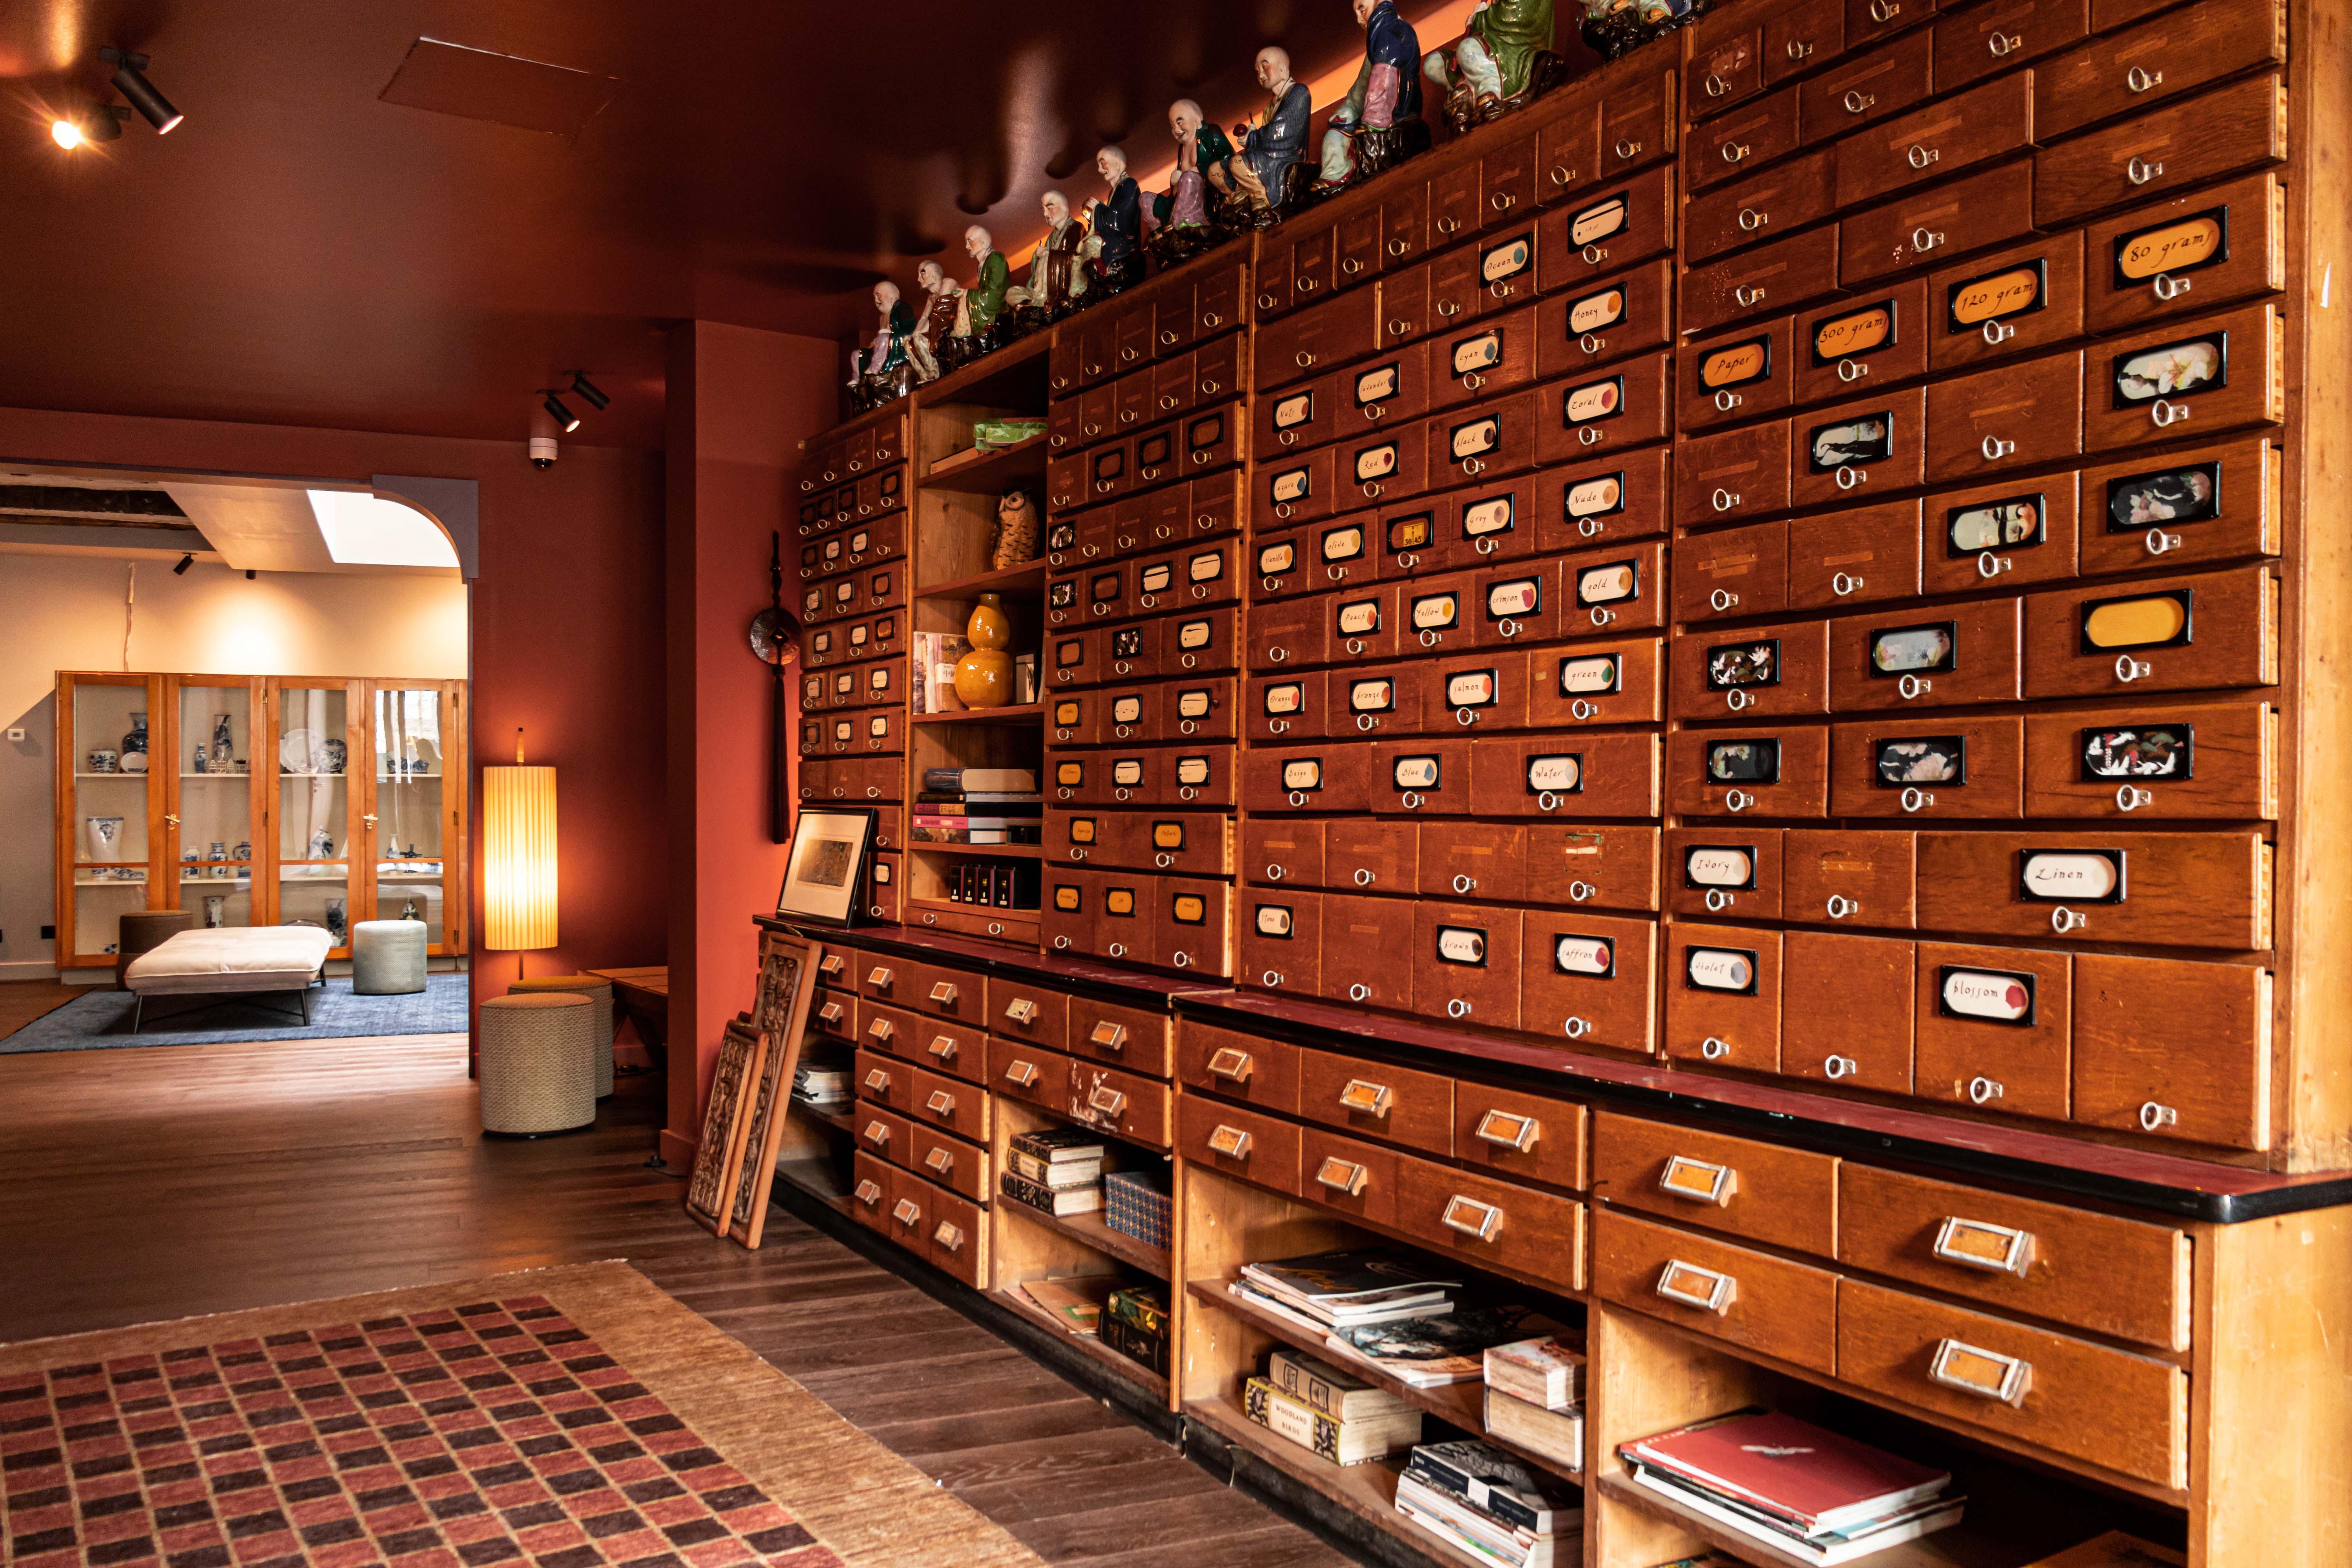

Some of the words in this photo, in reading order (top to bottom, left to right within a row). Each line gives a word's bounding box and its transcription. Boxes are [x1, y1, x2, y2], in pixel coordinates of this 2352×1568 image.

[2131, 245, 2150, 263] 80
[2152, 230, 2215, 268] grams
[1486, 258, 1511, 272] Ocean
[1962, 294, 1987, 311] 120
[1575, 308, 1598, 323] Honey
[1820, 326, 1844, 343] 300
[1460, 351, 1478, 368] cyan
[1364, 458, 1378, 470] Red
[1571, 494, 1597, 506] Nude
[1586, 578, 1607, 598] gold
[1492, 592, 1518, 604] crimson
[1569, 671, 1597, 686] green
[1535, 766, 1564, 779] Water
[1696, 859, 1730, 878] Ivory
[2034, 868, 2083, 881] Linen
[1276, 1404, 1308, 1425] WOODLAND
[1281, 1422, 1300, 1436] BIRDS
